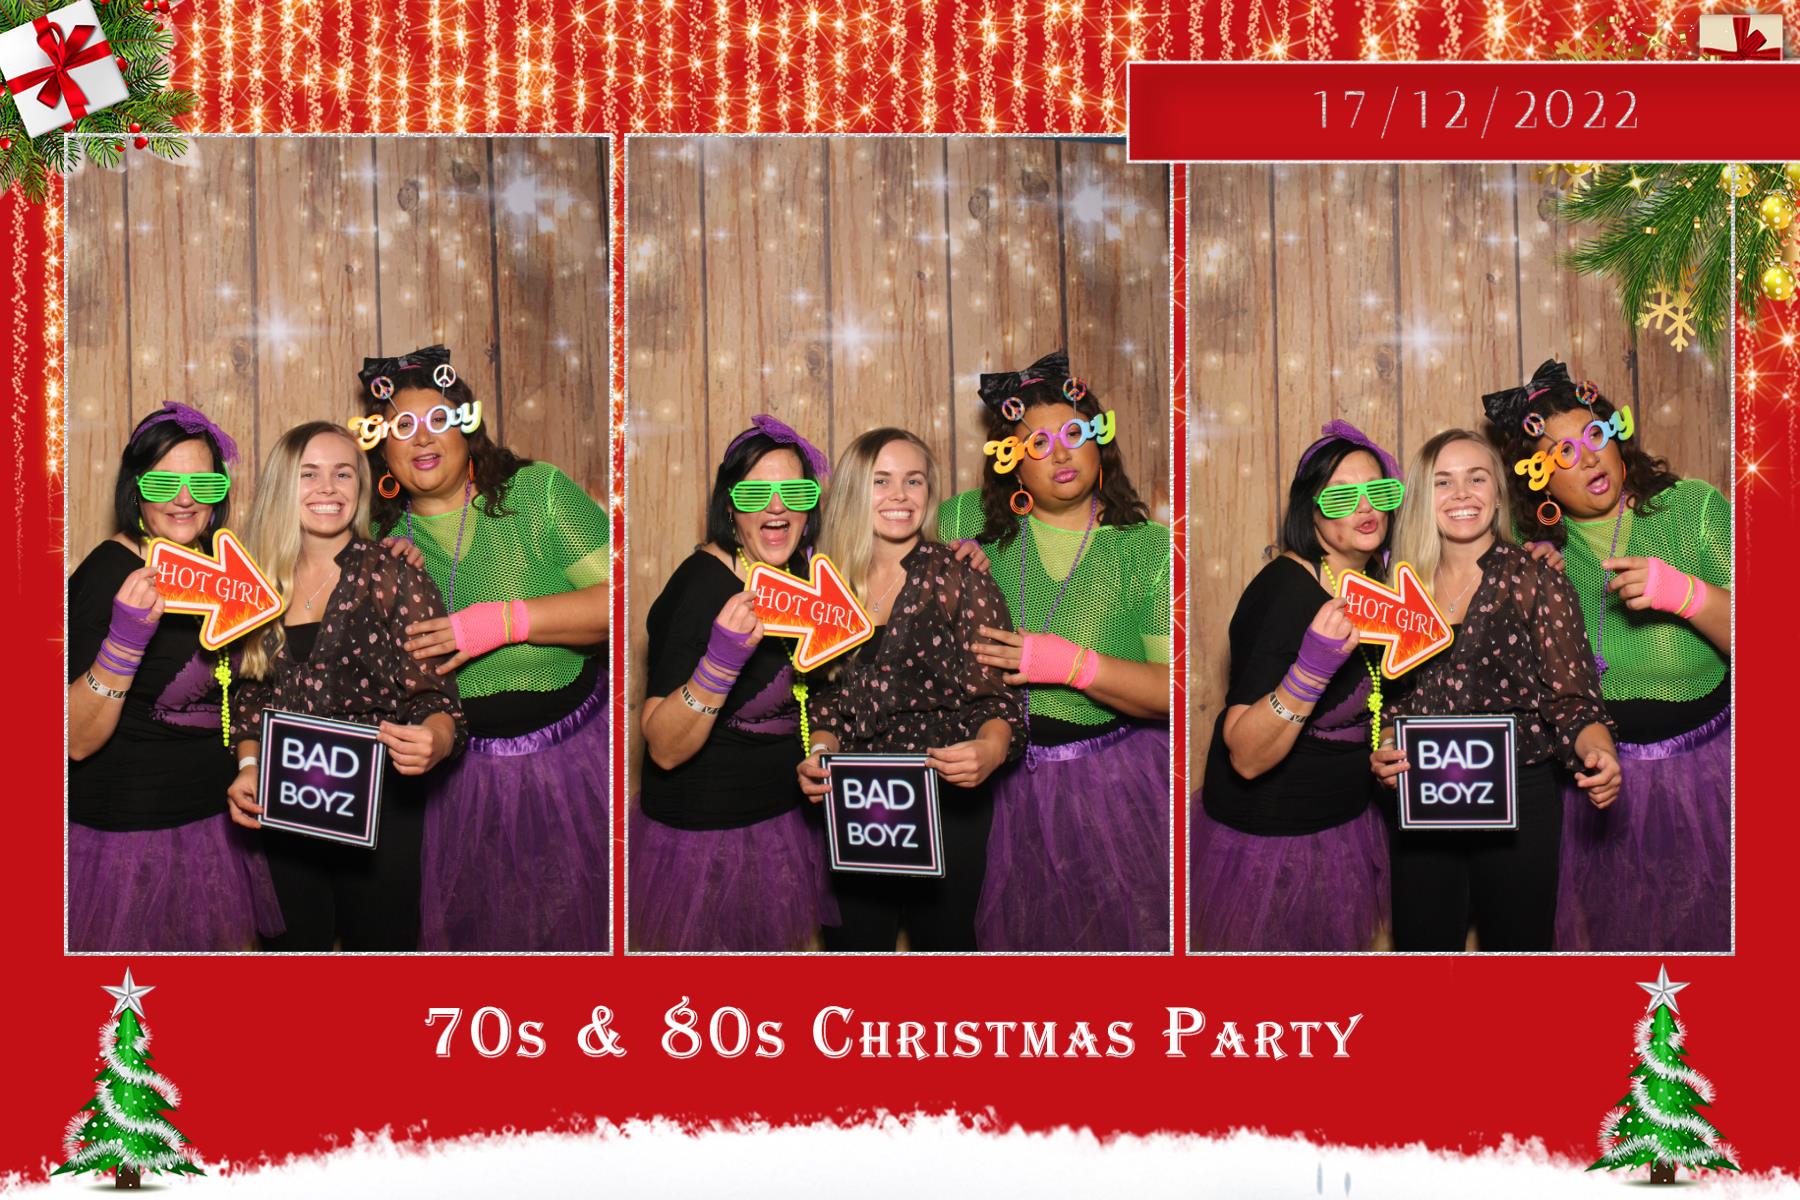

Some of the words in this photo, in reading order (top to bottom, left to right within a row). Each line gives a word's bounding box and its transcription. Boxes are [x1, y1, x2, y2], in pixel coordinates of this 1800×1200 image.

[158, 561, 213, 593] HOT
[215, 576, 266, 611] GIRL
[756, 585, 808, 616] HOT
[810, 601, 857, 634] GIRL
[1346, 592, 1394, 624] HOT
[1396, 608, 1438, 641] GIRL
[282, 737, 359, 778] BAD
[1418, 740, 1494, 769] BAD
[280, 781, 355, 817] BOYZ
[843, 778, 915, 810] BAD
[1420, 782, 1495, 804] BOYZ
[847, 822, 919, 848] BOYZ
